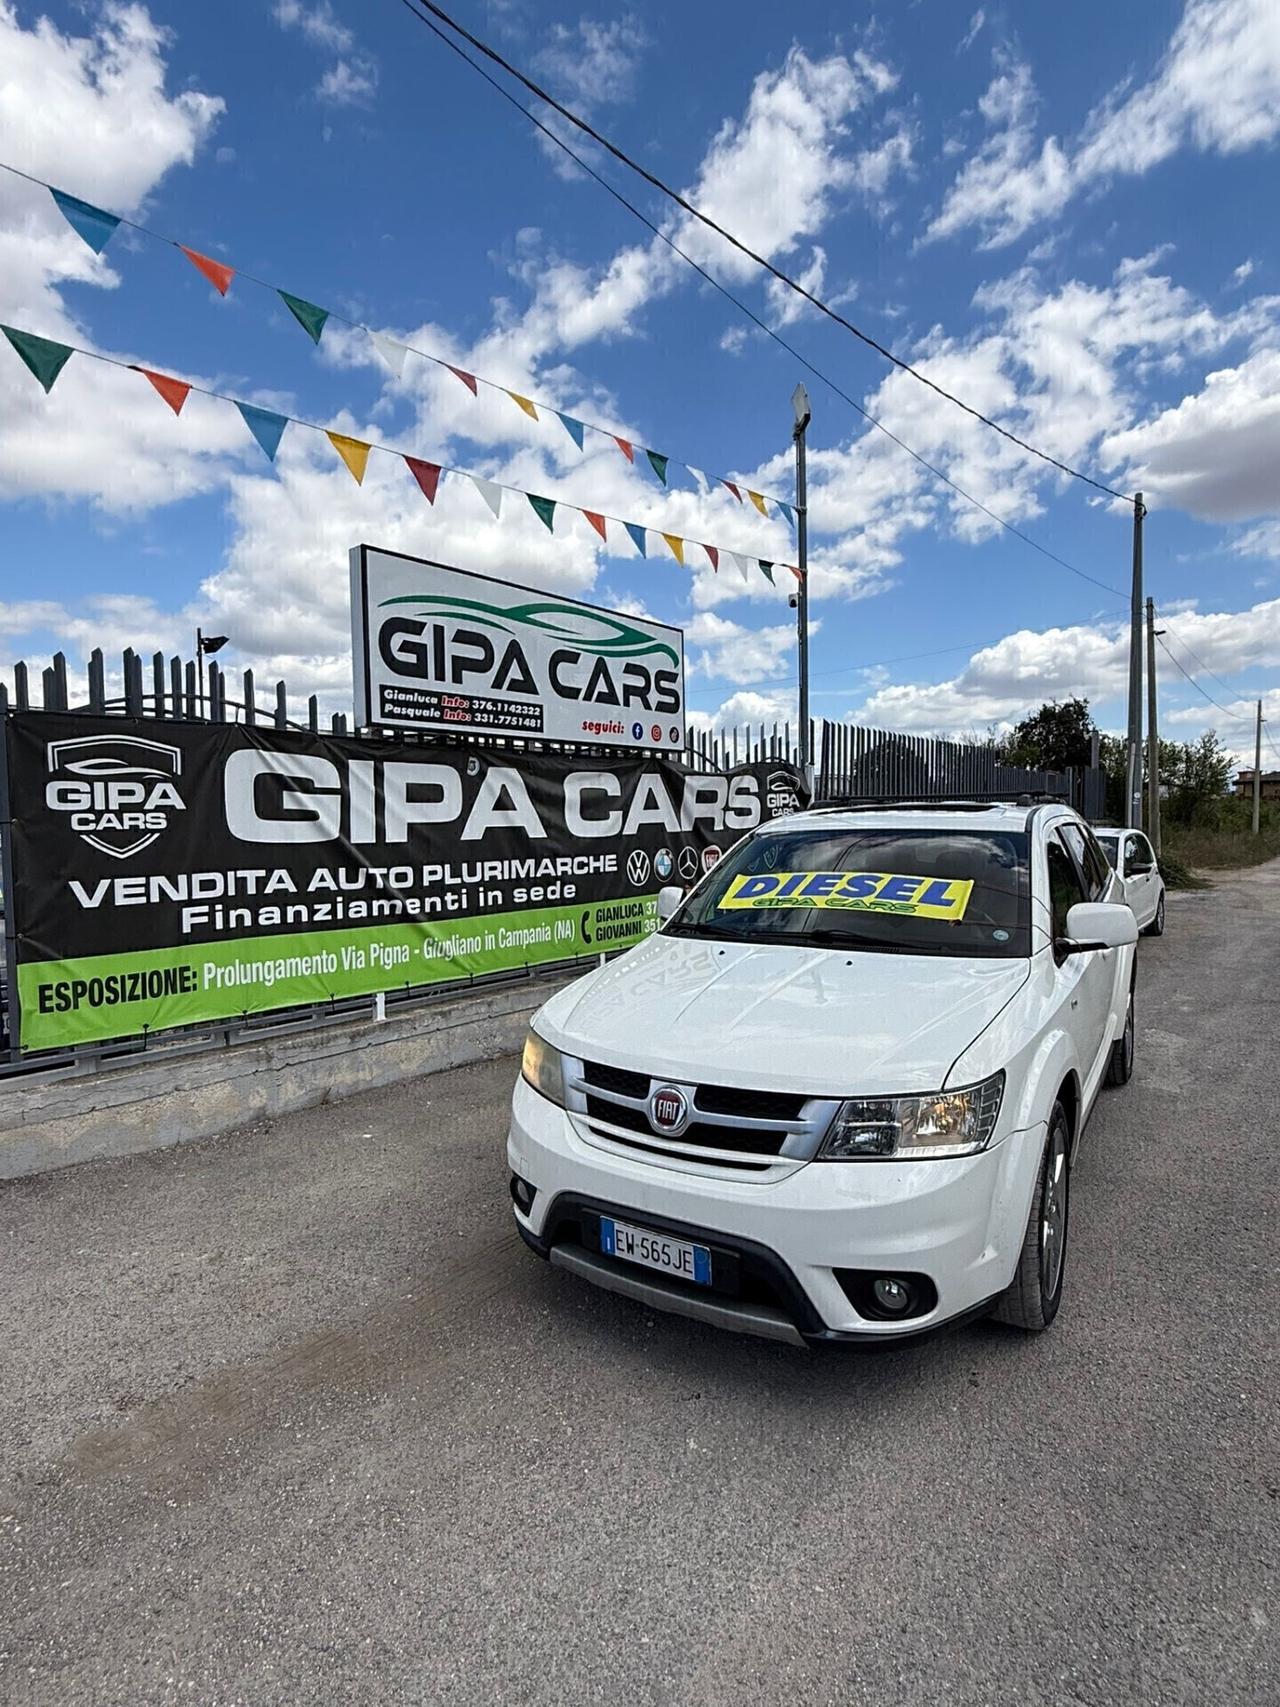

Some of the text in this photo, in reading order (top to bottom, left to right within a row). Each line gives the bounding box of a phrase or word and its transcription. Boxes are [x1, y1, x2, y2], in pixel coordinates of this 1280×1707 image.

[378, 616, 681, 714] GIPA CARS
[383, 689, 541, 716] Gianluca Info: 376.1142322
[384, 703, 541, 728] Pasquale Info: 331.7751481
[582, 720, 625, 735] seguici:
[45, 781, 187, 811] GIPA
[224, 748, 761, 844] GIPA CARS
[766, 793, 800, 808] GIPA
[70, 812, 168, 831] CARS
[68, 854, 618, 909] VENDITA AUTO PLURIMARCHE
[732, 874, 957, 907] DIESEL
[181, 882, 577, 934] Finanziamenti in sede
[595, 902, 644, 923] GIANLUCA
[752, 897, 918, 914] GIPA CARS
[595, 920, 642, 942] GIOVANNI
[38, 965, 198, 1014] ESPOSIZIONE:
[203, 951, 338, 990] Prolungamento
[341, 946, 366, 971] Via
[370, 942, 410, 970] Pigna
[423, 935, 482, 961] Giugliano
[484, 930, 496, 951] in
[499, 922, 551, 949] Campania
[554, 919, 575, 944] (NA)
[657, 1099, 679, 1121] FIAT
